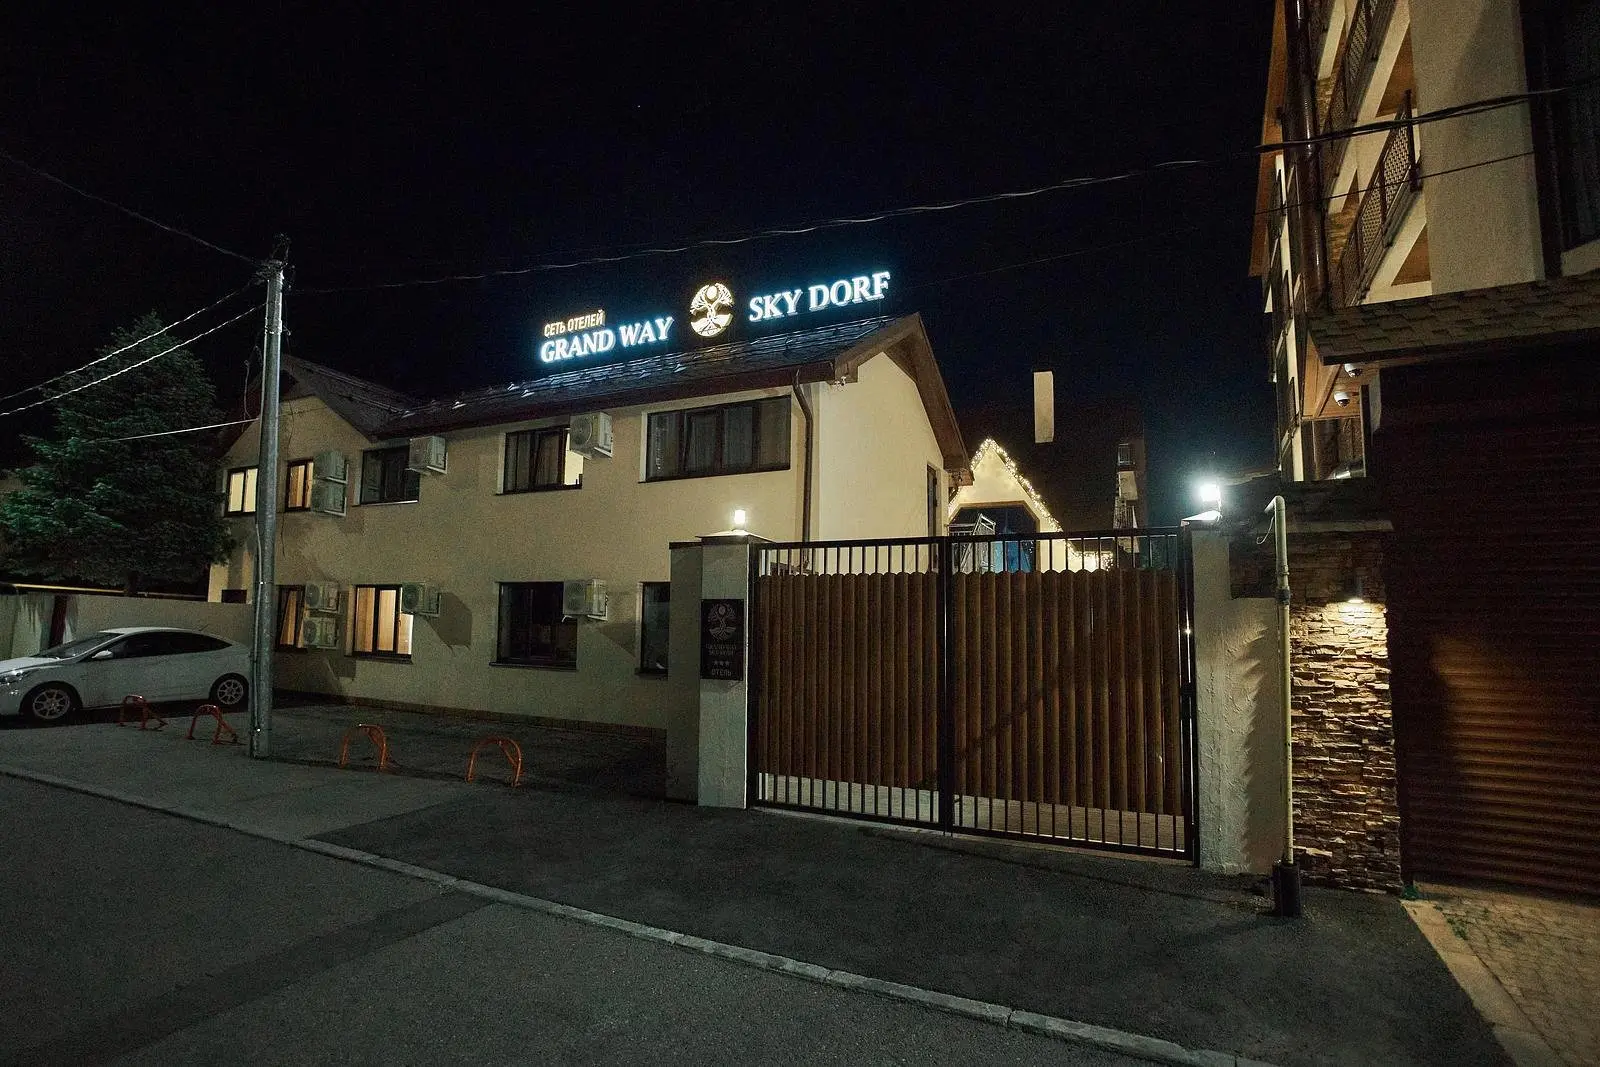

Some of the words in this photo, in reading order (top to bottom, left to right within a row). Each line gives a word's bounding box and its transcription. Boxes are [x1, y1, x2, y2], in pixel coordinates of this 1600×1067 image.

[749, 289, 803, 321] SKY
[808, 271, 890, 312] DORF
[541, 329, 616, 362] GRAND
[618, 316, 675, 347] WAY
[544, 321, 566, 338] СЕТЬ
[567, 309, 605, 332] ОТЕЛЕЙ
